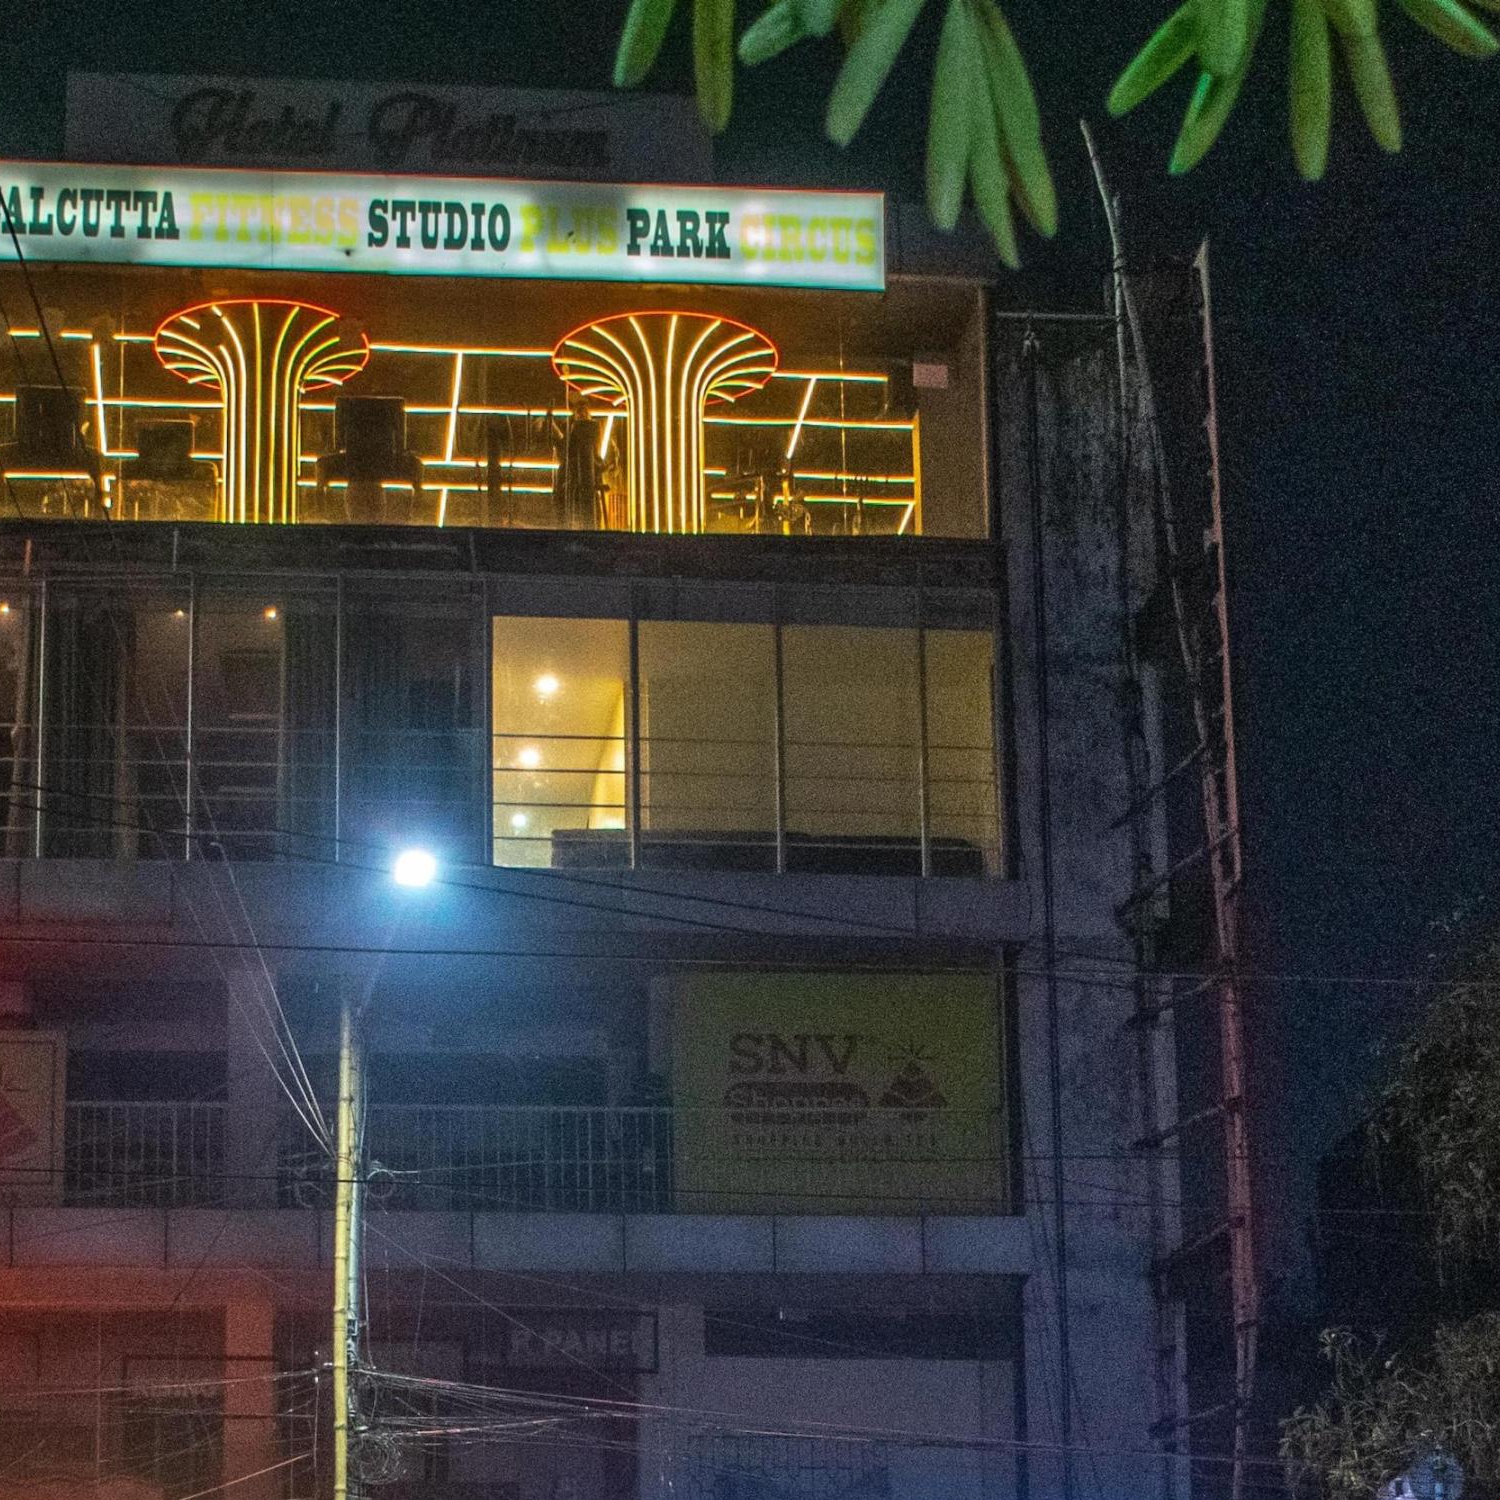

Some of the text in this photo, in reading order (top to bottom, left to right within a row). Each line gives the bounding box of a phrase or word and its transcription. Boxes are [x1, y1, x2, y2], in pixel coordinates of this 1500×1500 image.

[187, 191, 360, 248] FITNESS
[367, 196, 512, 253] STUDIO
[626, 207, 731, 260] PARK
[739, 212, 877, 266] CIRCUS
[729, 1033, 864, 1075] SNV
